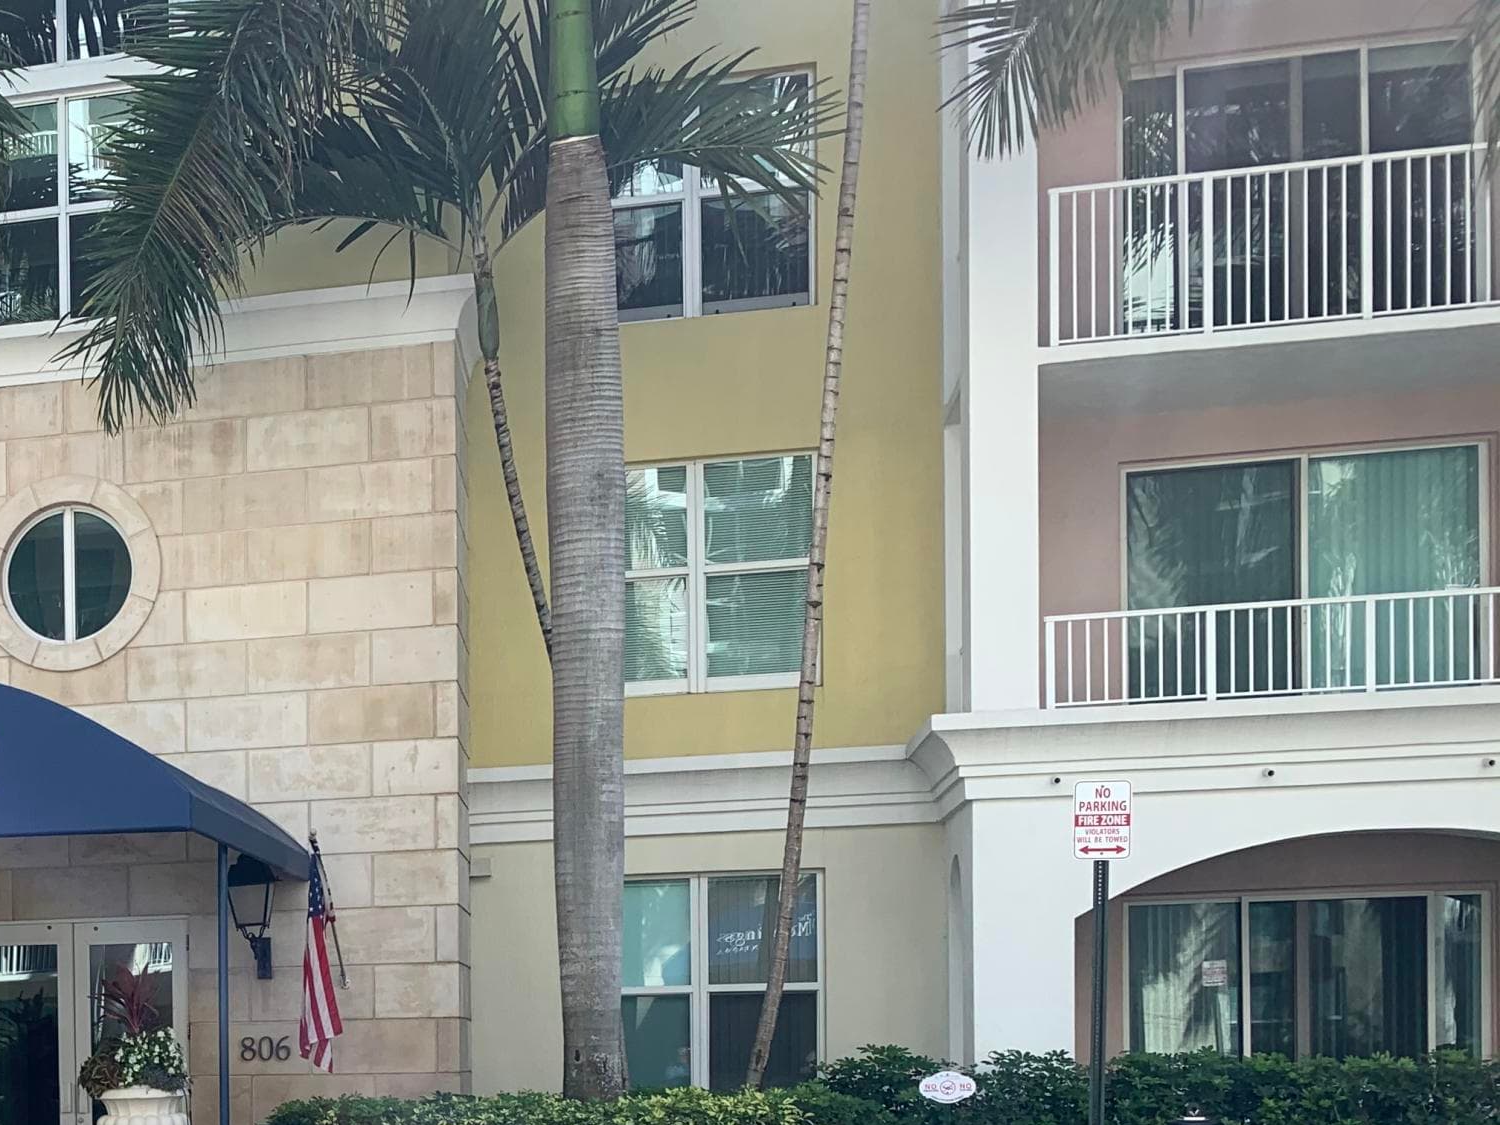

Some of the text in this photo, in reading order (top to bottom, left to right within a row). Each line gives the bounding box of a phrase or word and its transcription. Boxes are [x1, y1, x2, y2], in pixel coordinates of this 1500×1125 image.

[1095, 787, 1111, 799] NO
[1078, 800, 1127, 812] PARKING
[1078, 814, 1128, 826] FIRE ZONE
[1085, 828, 1120, 836] VIOLATORS
[1105, 835, 1128, 843] TOWED
[241, 1035, 290, 1061] 806
